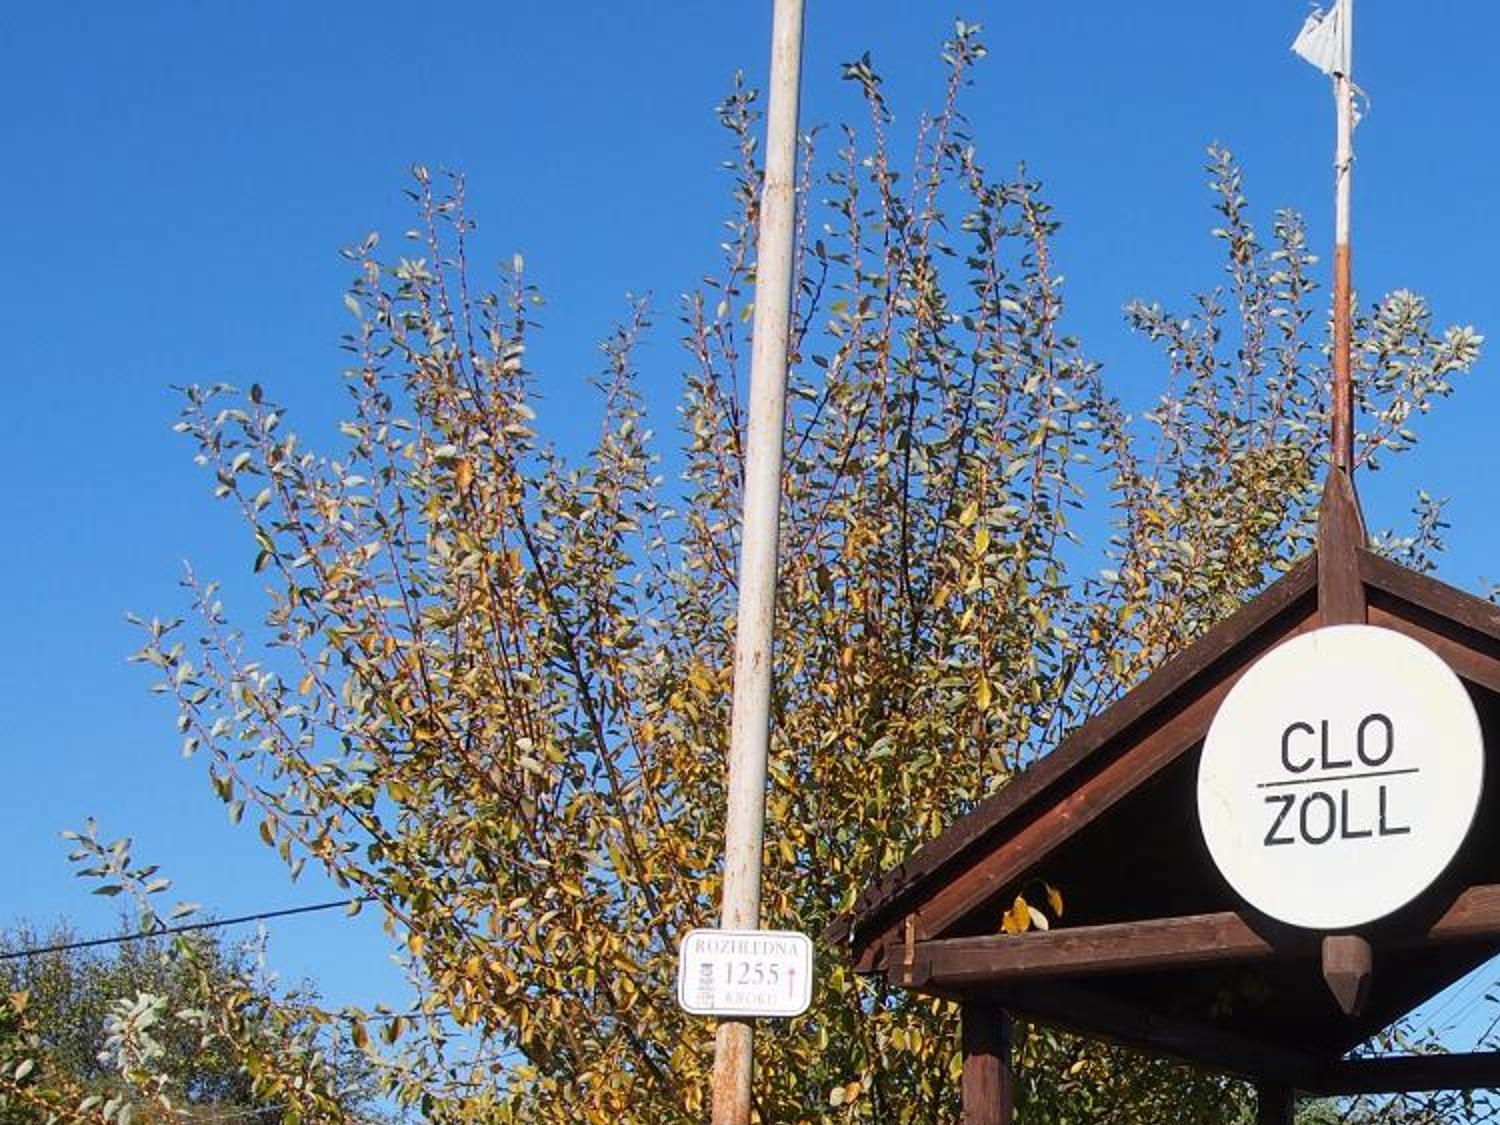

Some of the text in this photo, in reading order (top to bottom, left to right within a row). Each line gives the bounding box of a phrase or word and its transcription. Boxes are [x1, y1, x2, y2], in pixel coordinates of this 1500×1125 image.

[1281, 713, 1394, 773] CLO
[1264, 786, 1411, 846] ZOLL
[695, 939, 799, 956] ROZHLEDNA
[725, 961, 780, 985] 1255
